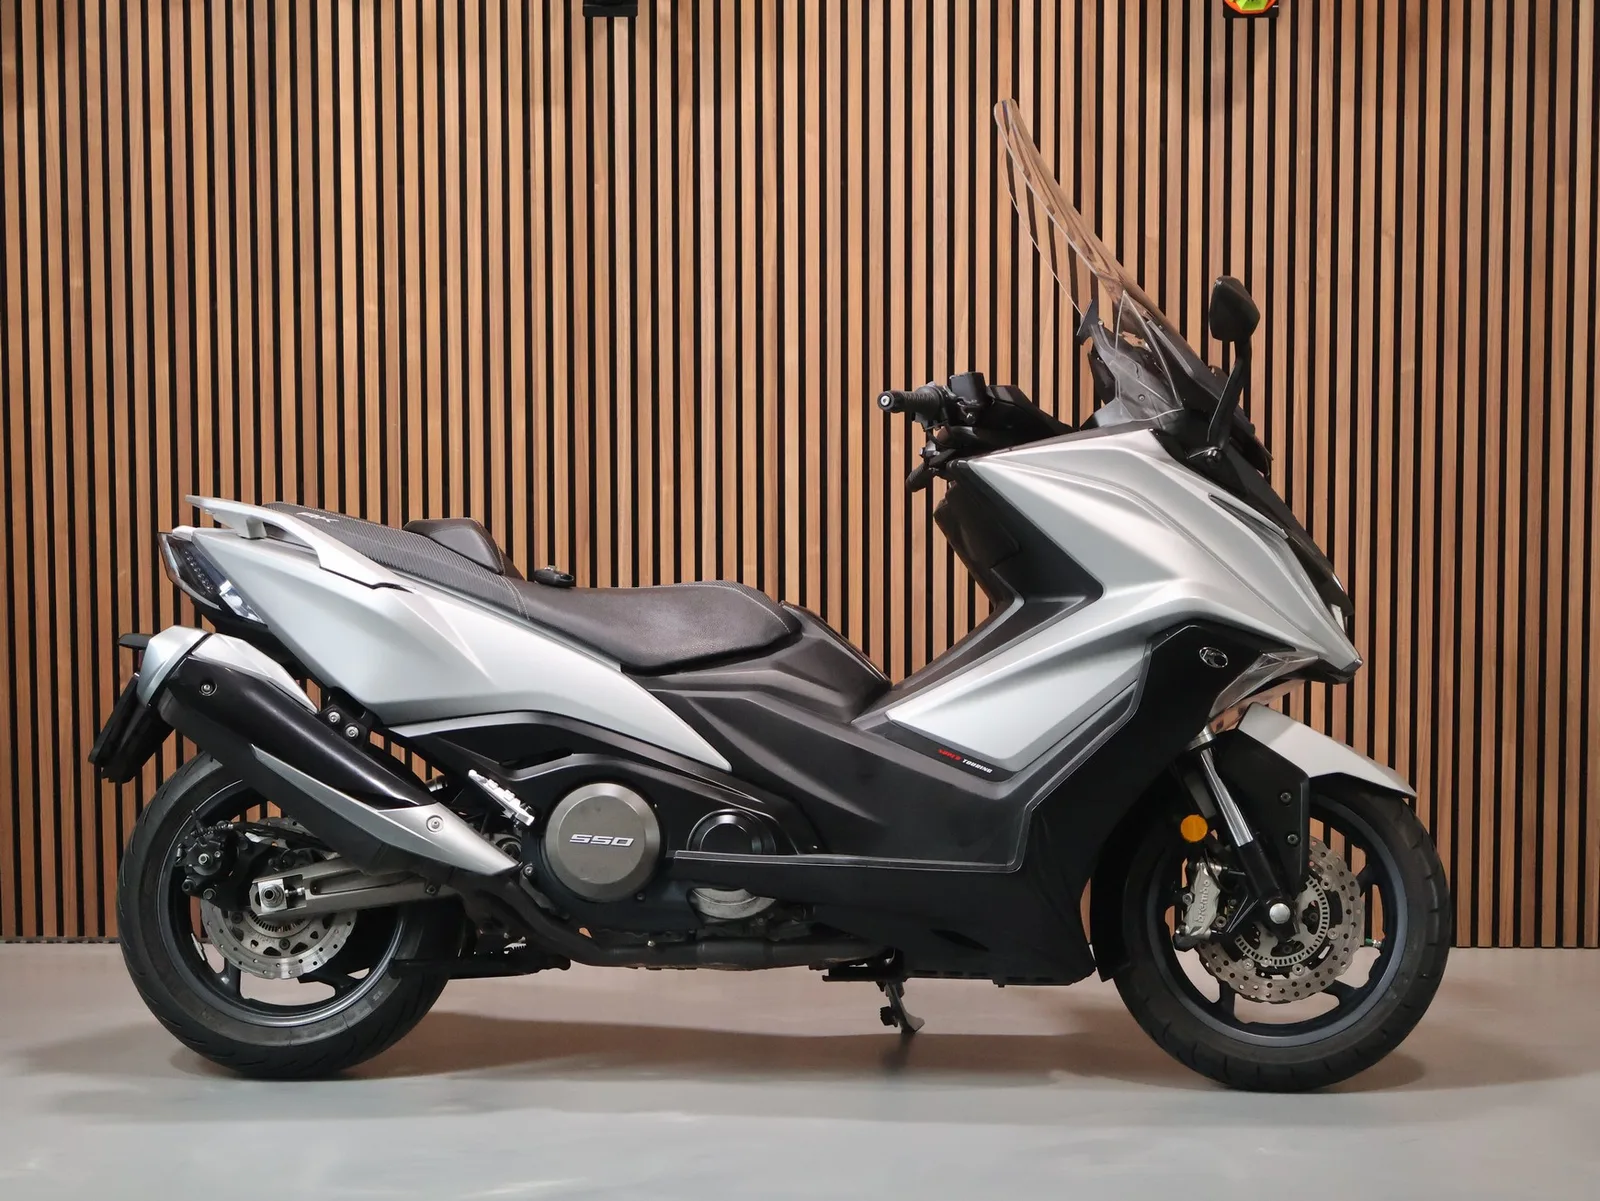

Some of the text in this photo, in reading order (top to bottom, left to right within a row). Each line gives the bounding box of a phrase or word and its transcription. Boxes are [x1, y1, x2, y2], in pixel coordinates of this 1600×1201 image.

[962, 758, 993, 774] TOURING
[569, 833, 635, 847] 550
[1195, 879, 1210, 923] brembo
